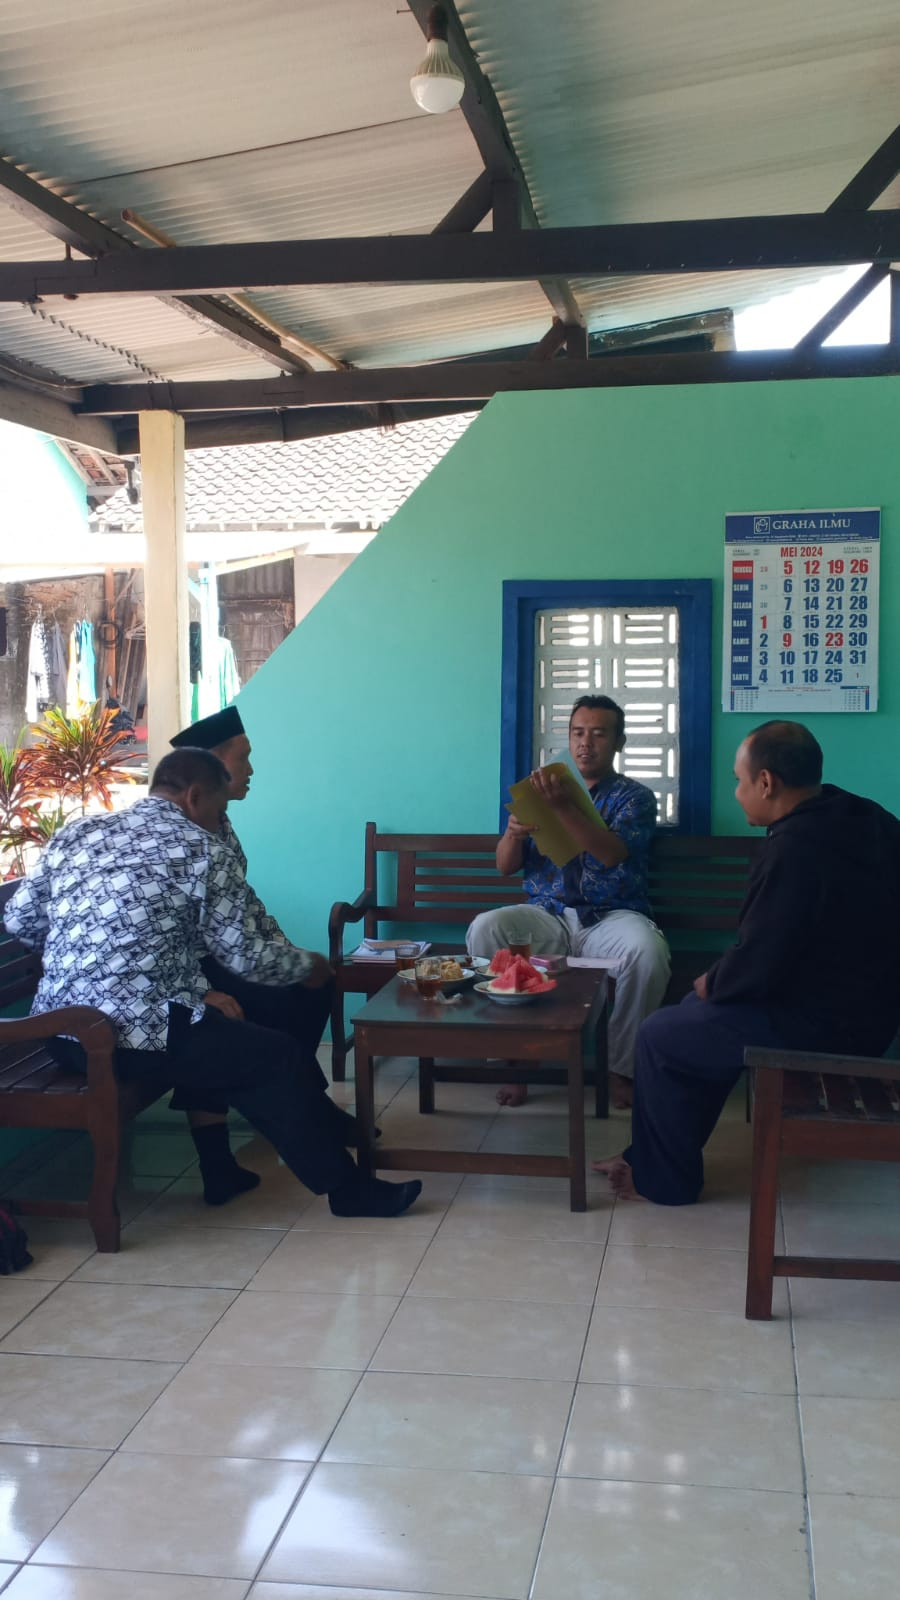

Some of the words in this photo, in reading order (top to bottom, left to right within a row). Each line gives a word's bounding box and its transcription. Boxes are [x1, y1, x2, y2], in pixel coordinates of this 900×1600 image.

[772, 520, 816, 530] GRAHA
[820, 519, 851, 528] ILMU
[780, 547, 797, 557] MEI
[800, 546, 823, 557] 2024
[784, 561, 793, 575] 5
[804, 560, 820, 574] 12
[827, 560, 844, 574] 19
[850, 559, 868, 573] 26
[784, 579, 792, 593] 6
[803, 578, 820, 592] 13
[826, 578, 844, 592] 20
[851, 578, 867, 591] 27
[784, 597, 792, 610] 7
[803, 596, 819, 610] 14
[826, 596, 842, 610] 21
[850, 596, 867, 610] 28
[760, 615, 767, 629] 1
[783, 615, 792, 629] 8
[803, 615, 819, 628] 15
[826, 614, 844, 628] 22
[849, 614, 867, 628] 29
[760, 633, 768, 647] 2
[783, 633, 792, 647] 9
[802, 633, 819, 647] 16
[825, 632, 844, 646] 23
[849, 632, 867, 646] 30
[760, 651, 768, 665] 3
[779, 651, 795, 665] 10
[803, 651, 818, 664] 17
[825, 650, 842, 664] 24
[850, 650, 866, 664] 31
[759, 669, 768, 682] 4
[780, 670, 794, 683] 11
[802, 669, 818, 682] 18
[825, 669, 843, 682] 25
